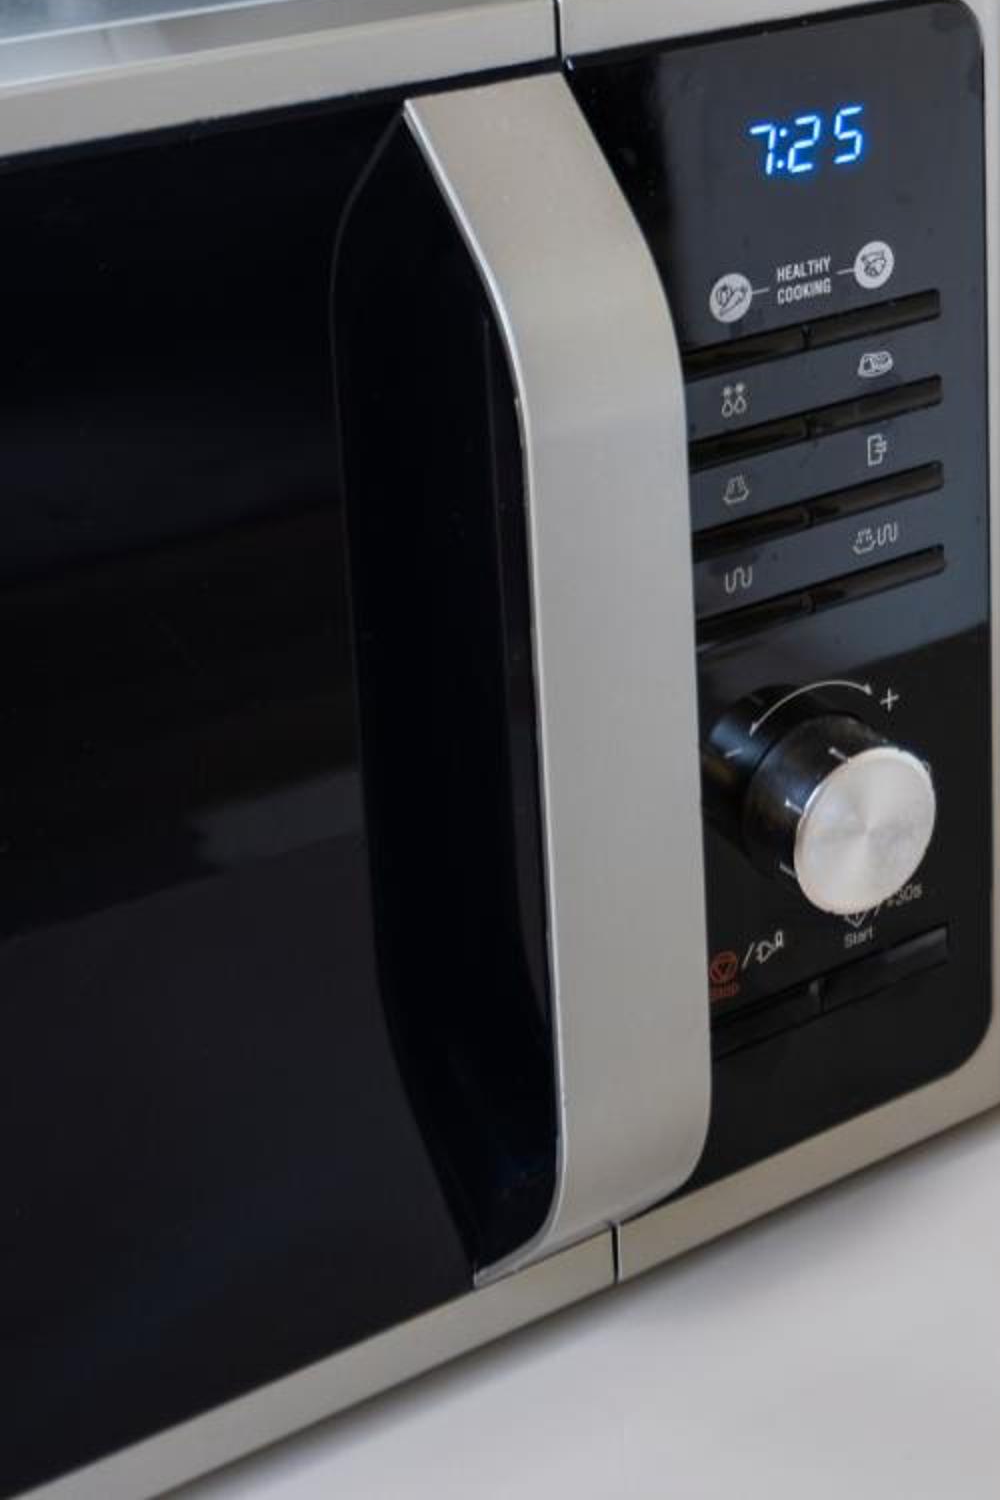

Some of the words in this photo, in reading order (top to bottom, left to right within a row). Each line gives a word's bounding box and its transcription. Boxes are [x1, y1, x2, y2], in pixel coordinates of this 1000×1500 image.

[749, 105, 864, 175] 7:25
[776, 256, 832, 281] HEALTHY
[777, 278, 832, 305] COOKING
[844, 925, 874, 949] Start
